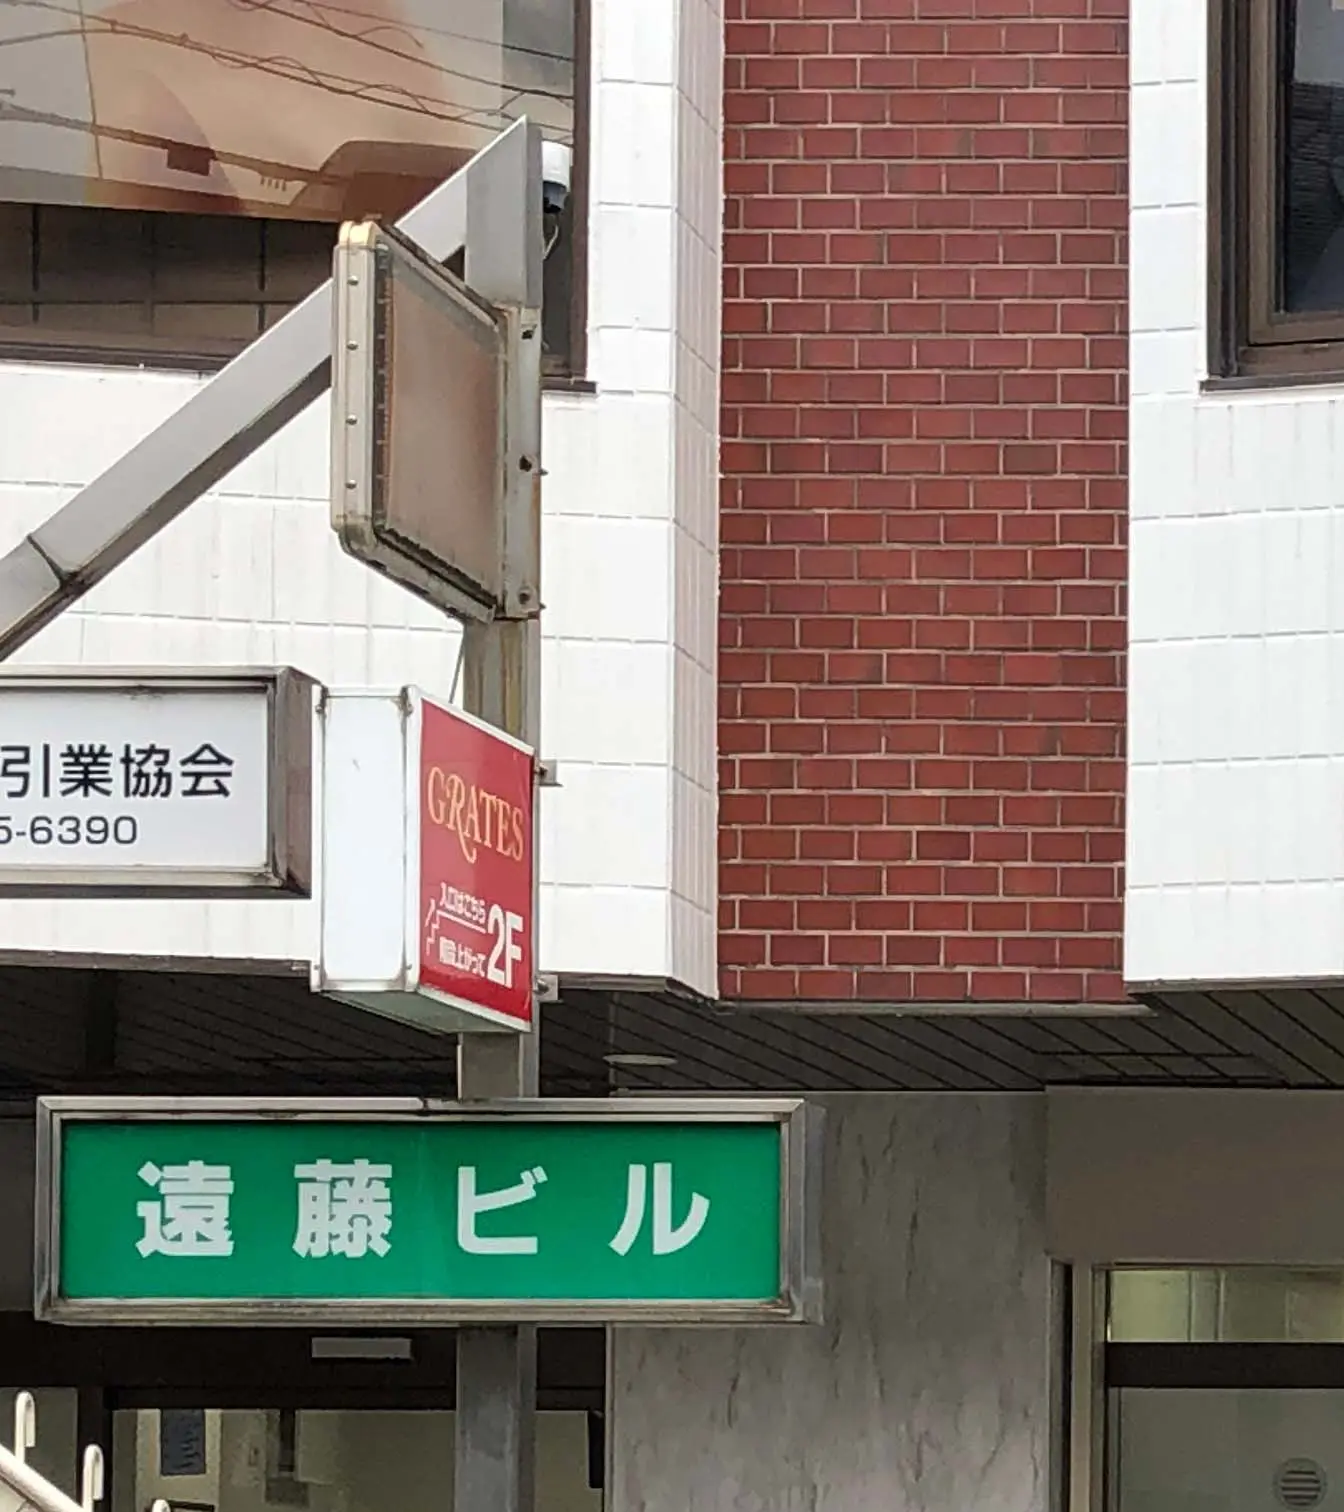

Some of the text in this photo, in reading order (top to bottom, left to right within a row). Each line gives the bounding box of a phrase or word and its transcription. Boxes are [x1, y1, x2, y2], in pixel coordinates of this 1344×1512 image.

[0, 743, 234, 798] 引業協会
[427, 766, 524, 864] GRATES
[488, 903, 523, 988] 2F
[135, 1158, 710, 1260] 遠藤ビル
